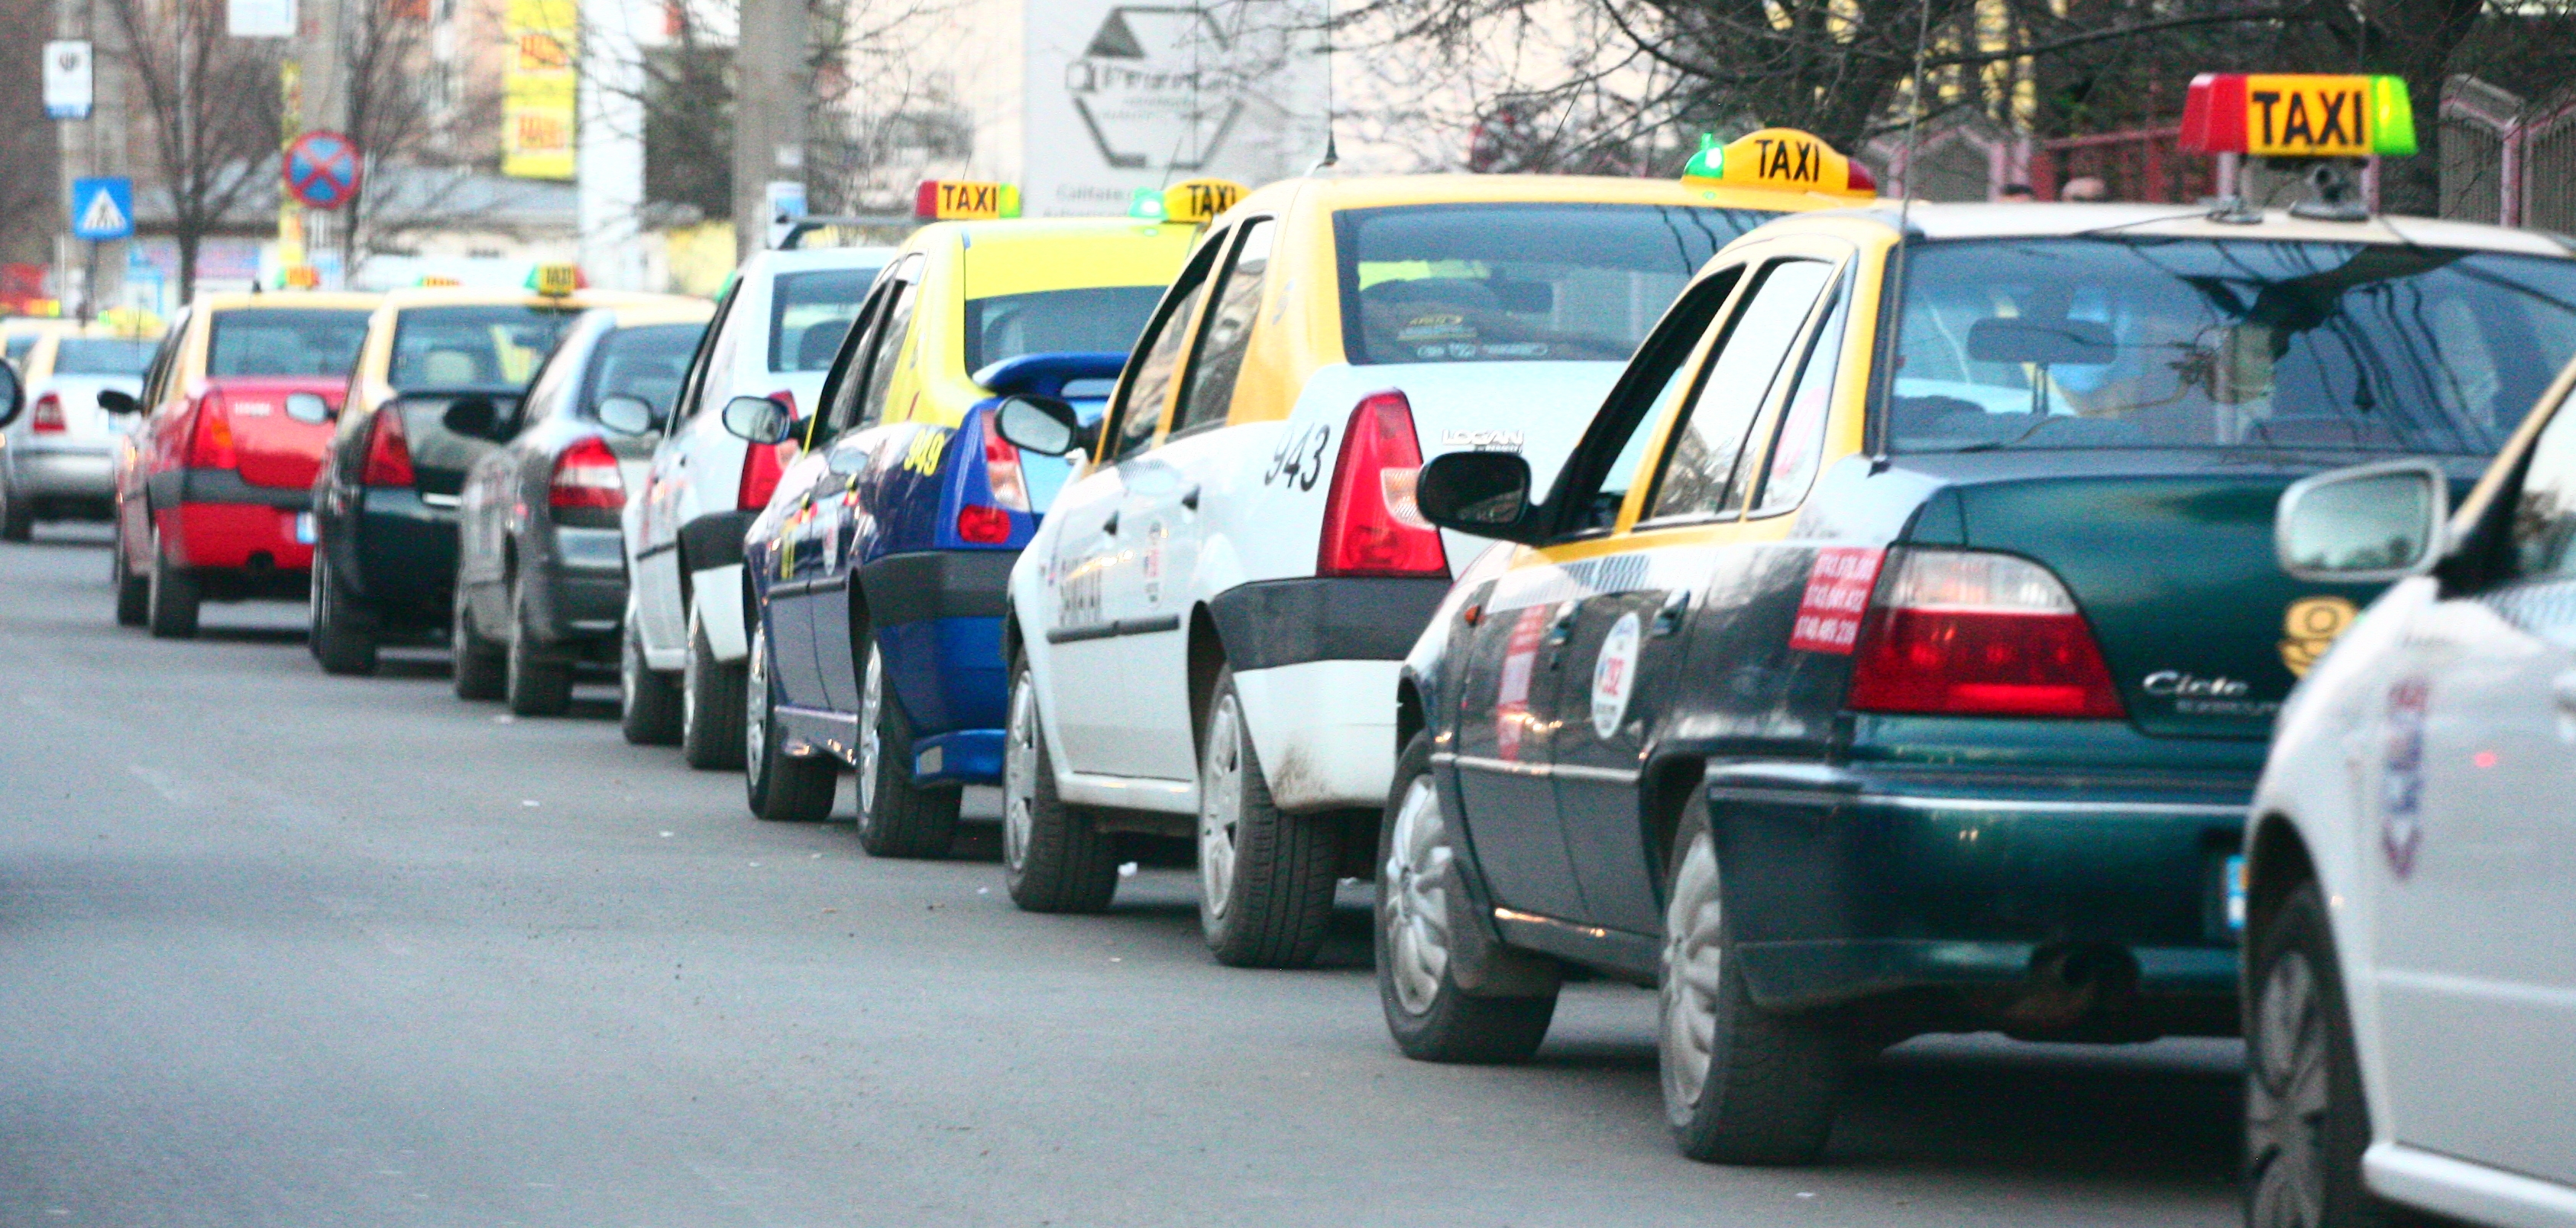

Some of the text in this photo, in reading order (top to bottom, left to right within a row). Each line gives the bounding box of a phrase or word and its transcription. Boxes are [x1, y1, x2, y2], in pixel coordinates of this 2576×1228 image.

[2252, 90, 2364, 145] TAXI
[1754, 139, 1820, 182] TAXI
[941, 185, 997, 212] TAXI
[1187, 184, 1237, 216] TAXI
[903, 428, 946, 477] 949
[1264, 421, 1331, 492] 943
[1441, 429, 1524, 446] LOGAN
